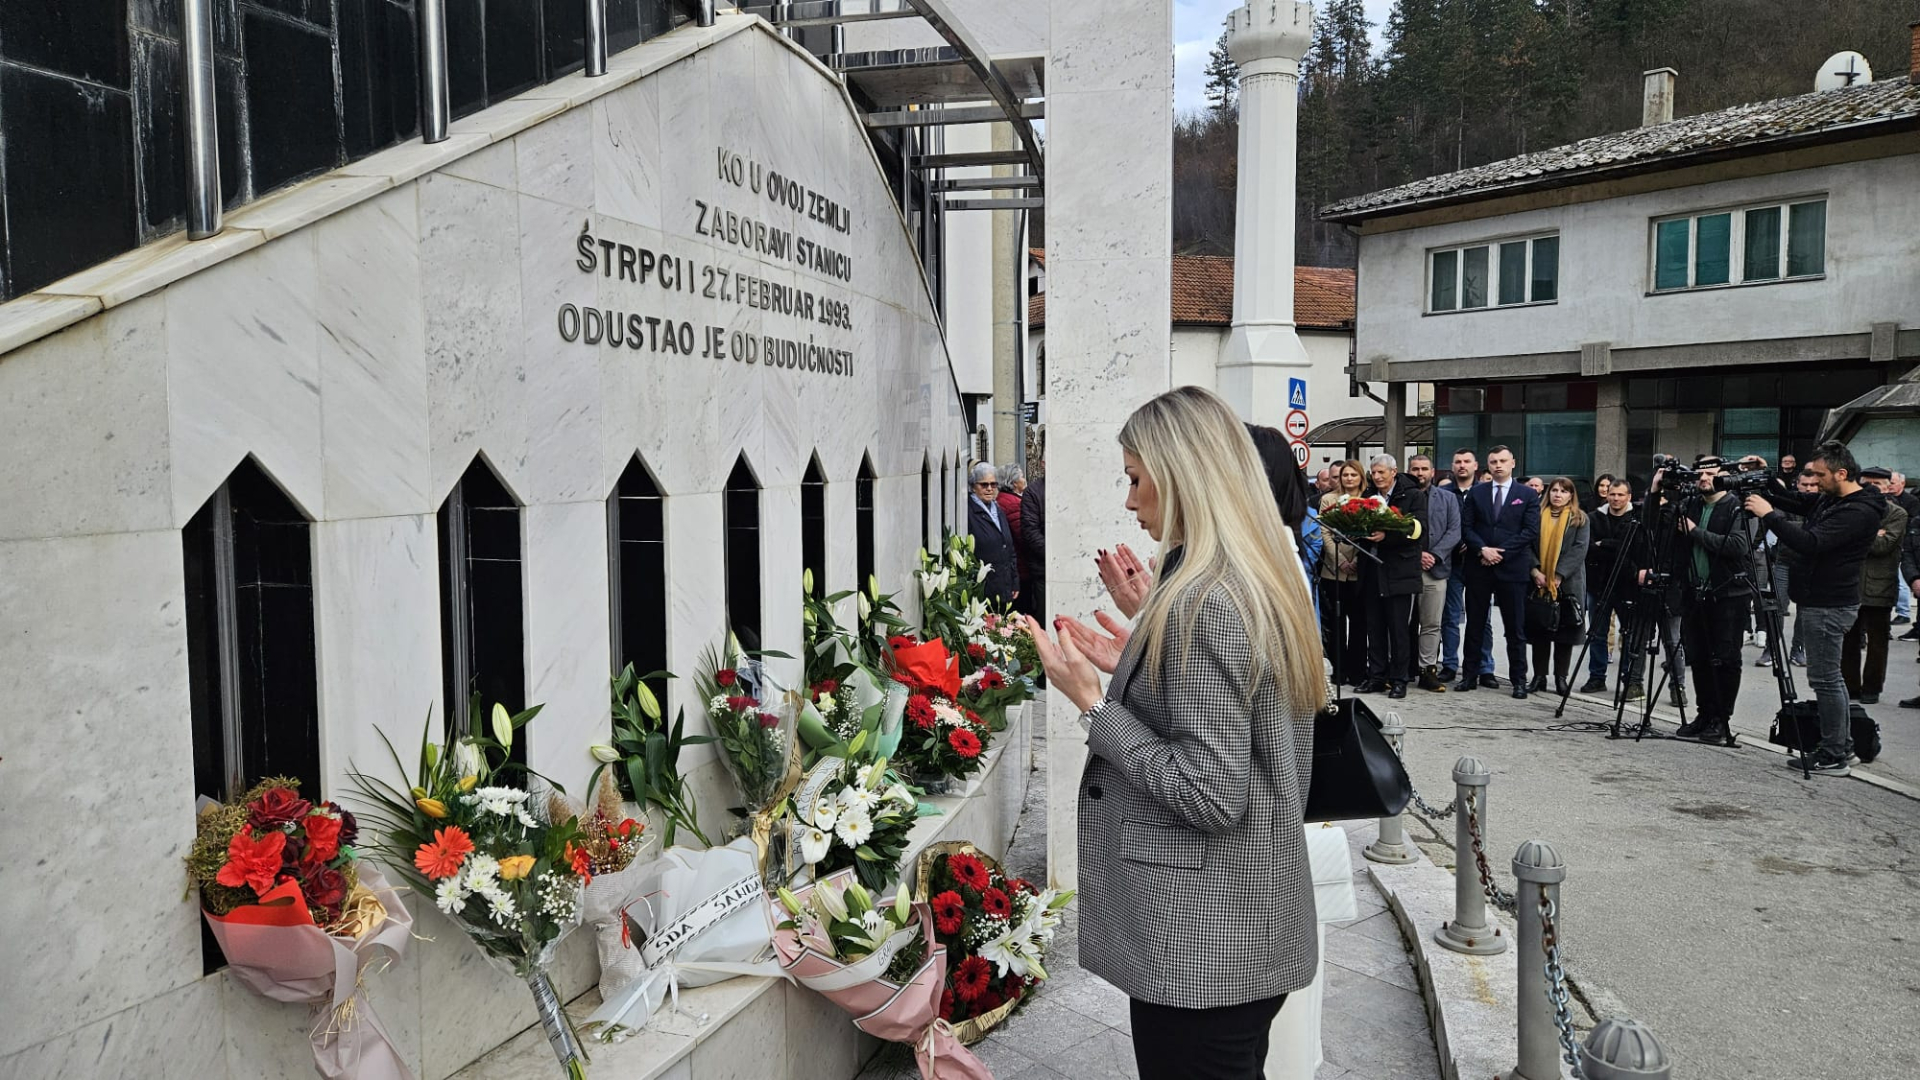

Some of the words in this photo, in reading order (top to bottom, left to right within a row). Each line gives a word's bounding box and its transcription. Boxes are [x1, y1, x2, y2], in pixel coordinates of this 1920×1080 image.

[717, 146, 744, 187] KO
[749, 160, 761, 194] U
[766, 170, 804, 214] OVOJ
[807, 189, 850, 236] ZEMLJI
[695, 199, 792, 262] ZABORAVI
[796, 236, 851, 283] STANICU
[688, 259, 695, 294] I
[817, 296, 852, 330] 1993.
[558, 302, 695, 356] ODUSTAO
[702, 325, 726, 359] JE
[731, 330, 758, 364] OD
[655, 923, 694, 953] SDA
